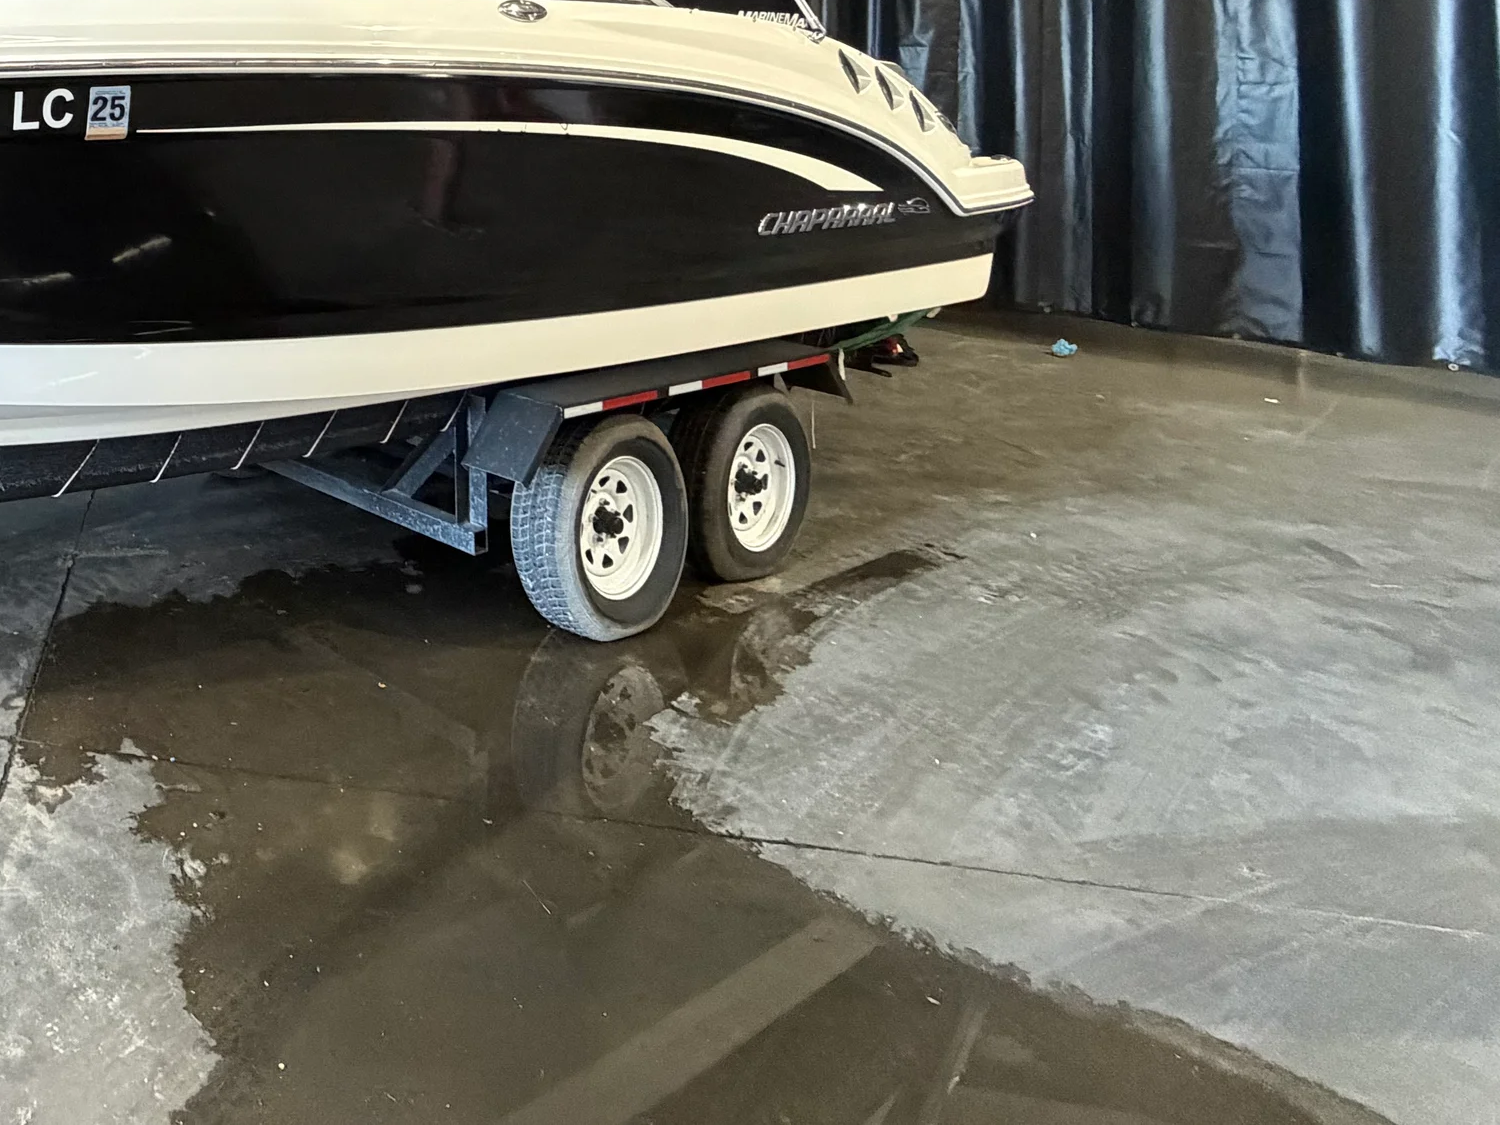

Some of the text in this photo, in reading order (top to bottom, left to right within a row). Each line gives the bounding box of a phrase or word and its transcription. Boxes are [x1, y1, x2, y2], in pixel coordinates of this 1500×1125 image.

[738, 10, 807, 28] ARINEMA
[13, 88, 74, 131] LC
[91, 95, 126, 121] 25
